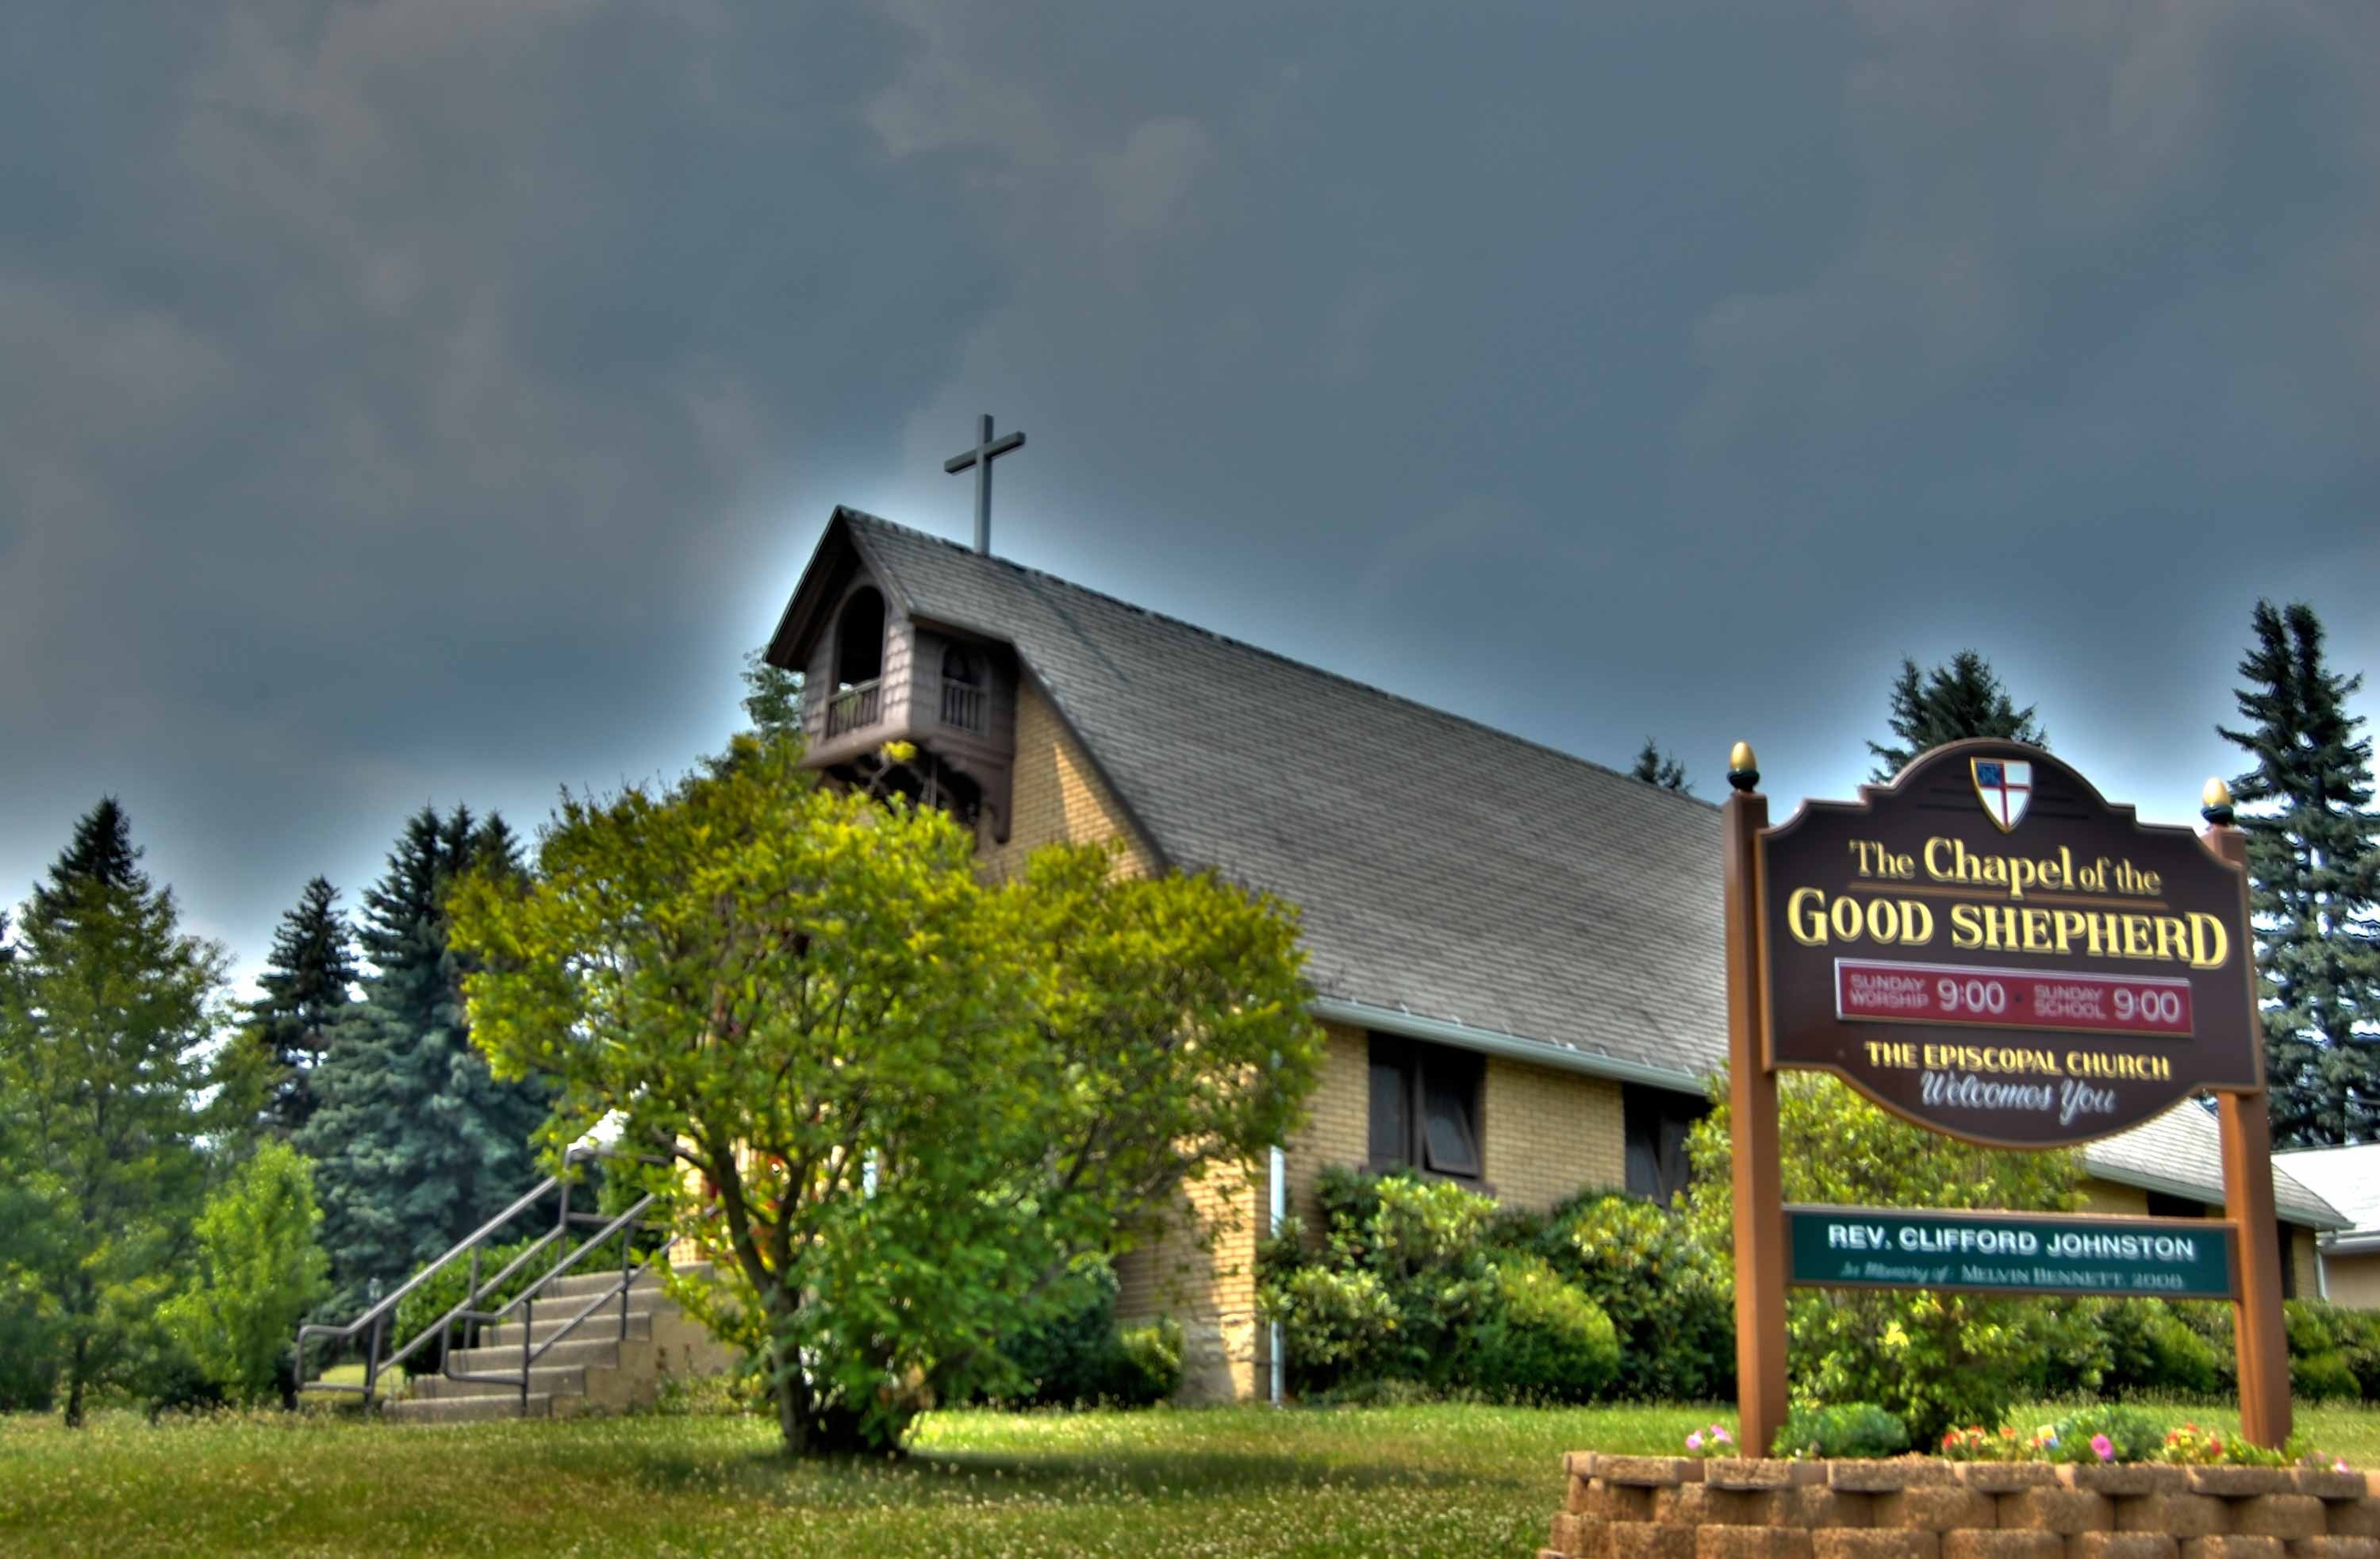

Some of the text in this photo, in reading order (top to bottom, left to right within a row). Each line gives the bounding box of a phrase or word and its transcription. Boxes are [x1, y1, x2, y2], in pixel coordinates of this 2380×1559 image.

[1849, 835, 2163, 900] The Chapel of the
[1787, 886, 2228, 970] GOOD SHEPHERD
[1849, 973, 1926, 990] SUNDAY
[1849, 990, 1929, 1008] WORSHIP
[1937, 978, 2006, 1014] 9:00
[2033, 984, 2104, 1001] SUNDAY
[2034, 998, 2107, 1019] SCHOOL
[2113, 989, 2180, 1023] 9:00
[1864, 1041, 2172, 1081] THE EPISCOPAL CHURCH
[1921, 1071, 2117, 1126] Welcomes You
[1828, 1225, 2195, 1261] REV. CLIFFORD JOHNSTON
[1960, 1263, 2029, 1284] MELVIN
